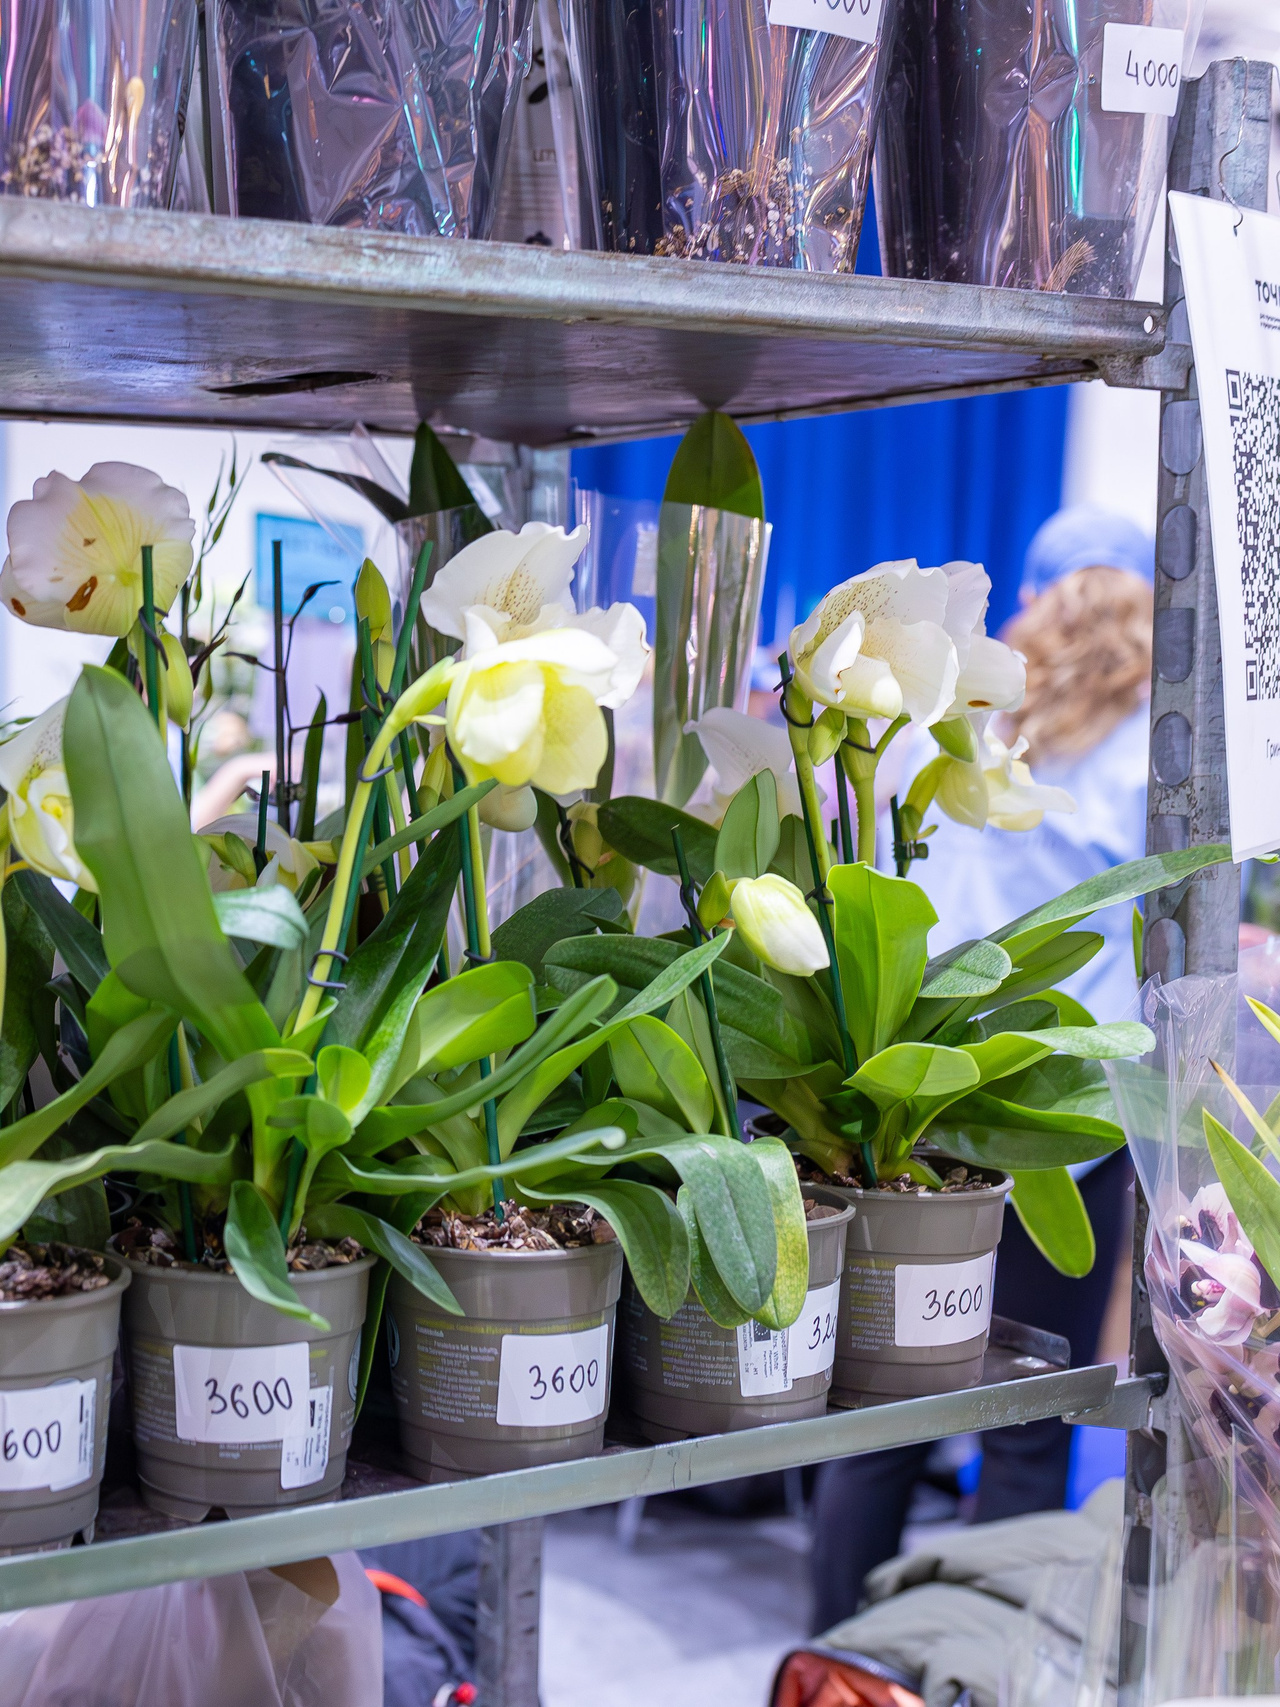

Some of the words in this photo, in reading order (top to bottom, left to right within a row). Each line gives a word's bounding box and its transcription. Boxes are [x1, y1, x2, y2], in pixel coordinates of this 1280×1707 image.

[1124, 49, 1179, 89] 4000
[922, 1284, 984, 1321] 3600
[204, 1377, 293, 1419] 3600
[528, 1358, 599, 1400] 3600
